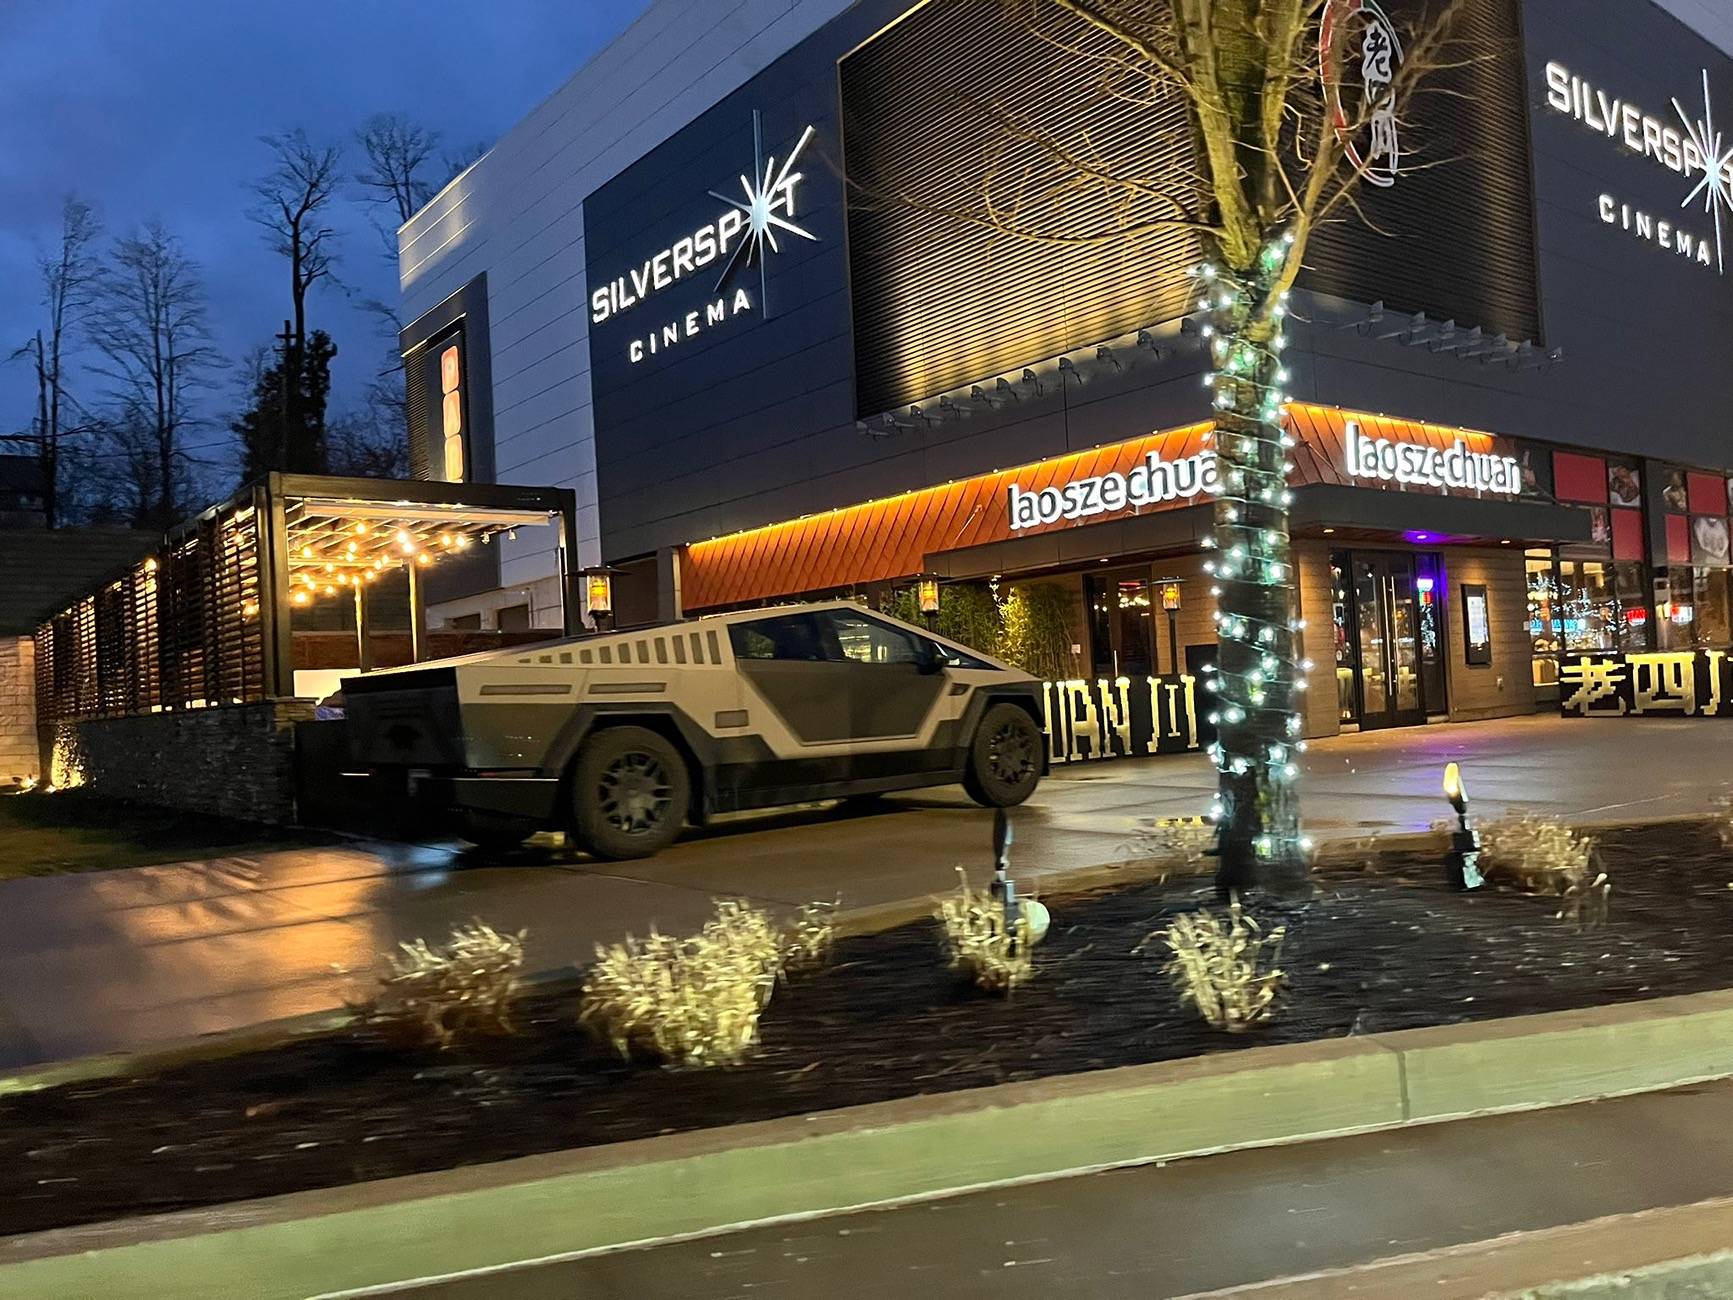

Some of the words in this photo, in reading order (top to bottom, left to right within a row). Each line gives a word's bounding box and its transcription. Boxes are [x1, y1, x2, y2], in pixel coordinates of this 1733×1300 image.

[1598, 194, 1711, 267] CINEMA
[629, 288, 751, 363] CINEMA
[1006, 450, 1219, 530] laoszechua
[1345, 420, 1523, 495] laoszechuan
